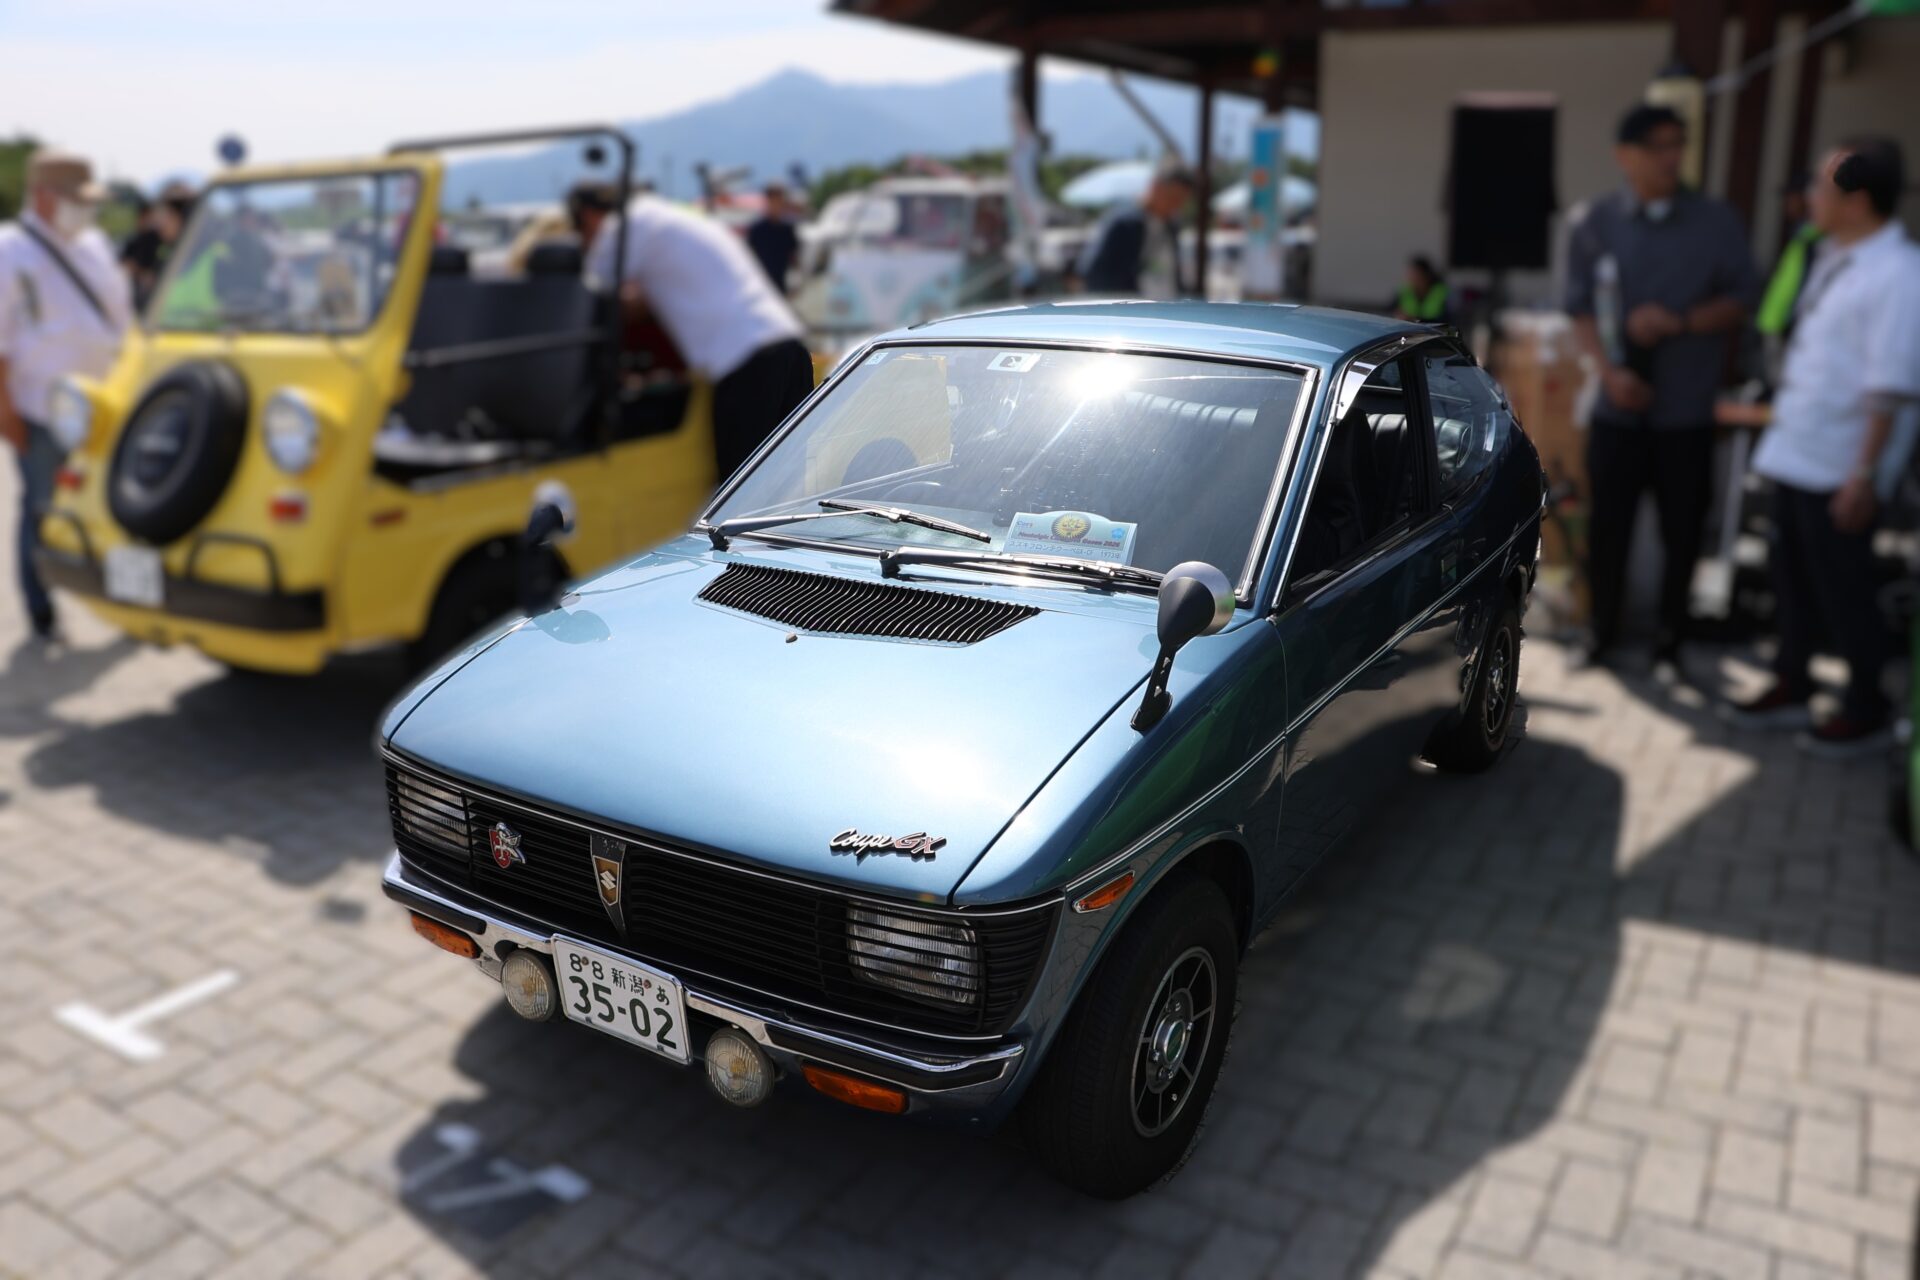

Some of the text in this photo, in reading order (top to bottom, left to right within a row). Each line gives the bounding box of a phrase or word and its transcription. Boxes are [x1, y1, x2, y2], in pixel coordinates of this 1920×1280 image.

[829, 826, 947, 857] Coupe GX
[610, 967, 645, 997] 新潟
[656, 984, 670, 1006] あ
[568, 975, 677, 1050] 35-02
